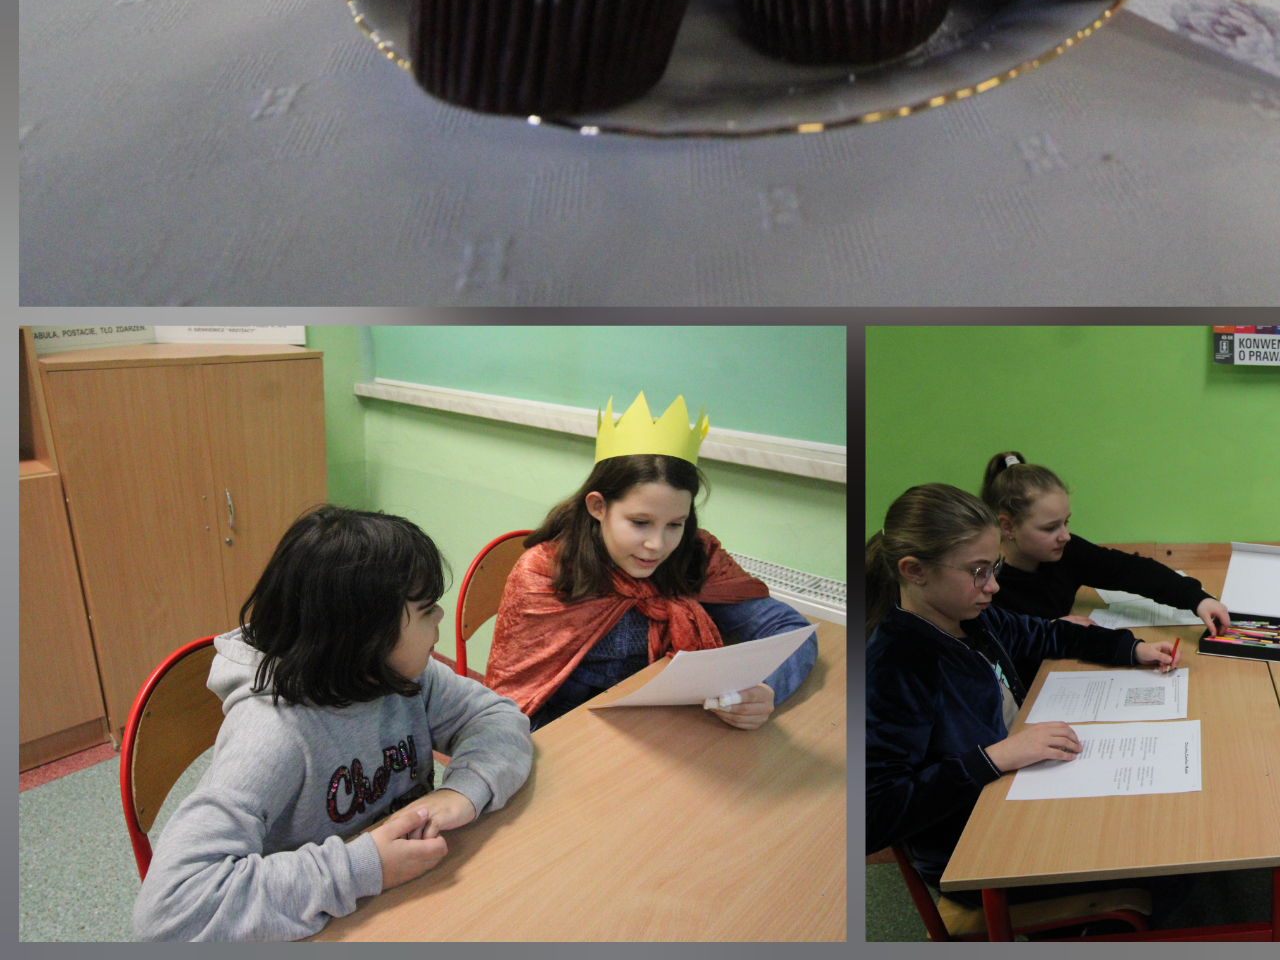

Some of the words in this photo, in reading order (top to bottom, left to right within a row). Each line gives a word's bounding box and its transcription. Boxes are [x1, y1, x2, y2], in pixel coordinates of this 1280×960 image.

[33, 330, 60, 340] ABUŁA,
[62, 327, 98, 337] POSTACIE,
[100, 326, 113, 334] TŁO
[1238, 351, 1246, 361] O
